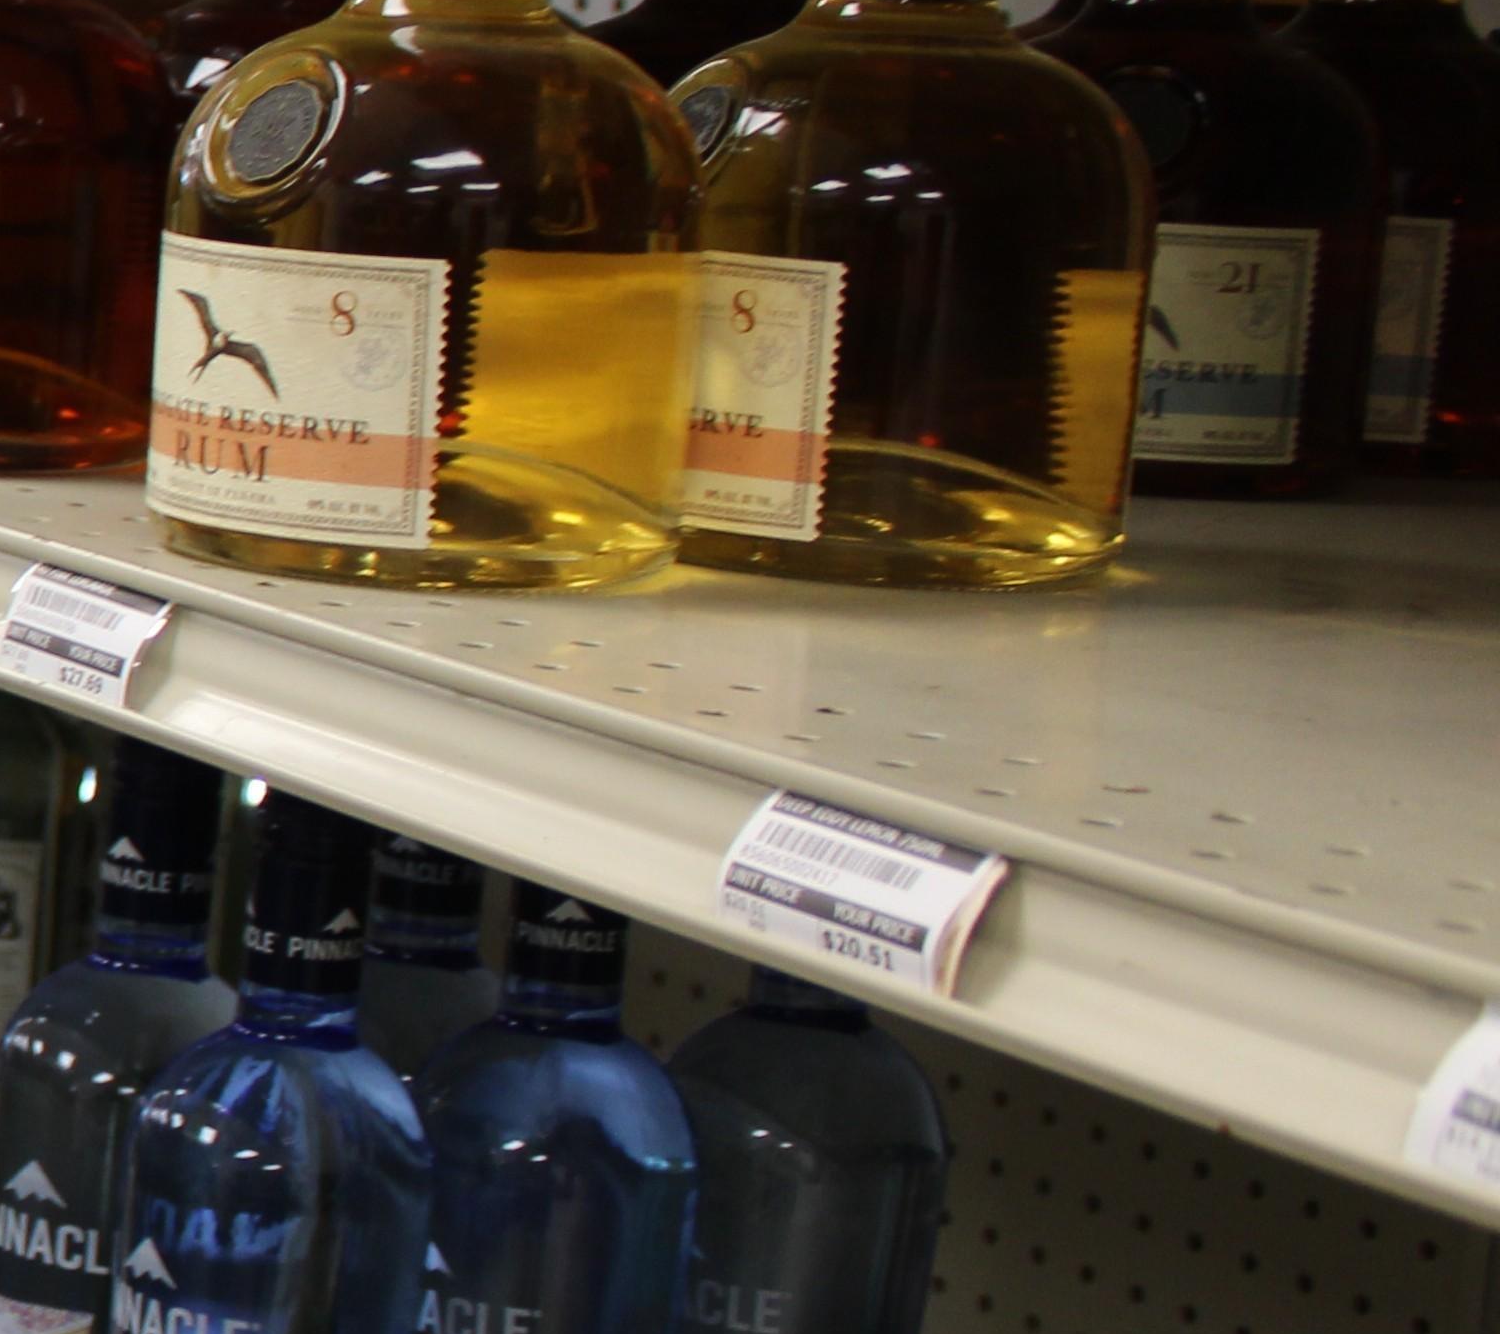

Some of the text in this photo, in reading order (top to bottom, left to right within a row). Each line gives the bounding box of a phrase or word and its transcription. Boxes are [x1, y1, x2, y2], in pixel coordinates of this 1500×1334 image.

[330, 290, 359, 338] 8
[730, 288, 758, 334] 8
[218, 405, 372, 446] RESERVE
[174, 429, 272, 483] RUM
[848, 813, 900, 843] LEMON
[758, 875, 803, 905] PRICE
[831, 900, 874, 929] YOUR
[869, 915, 919, 945] PRICE
[518, 920, 619, 953] PINNACLE
[820, 929, 896, 972] $20.51
